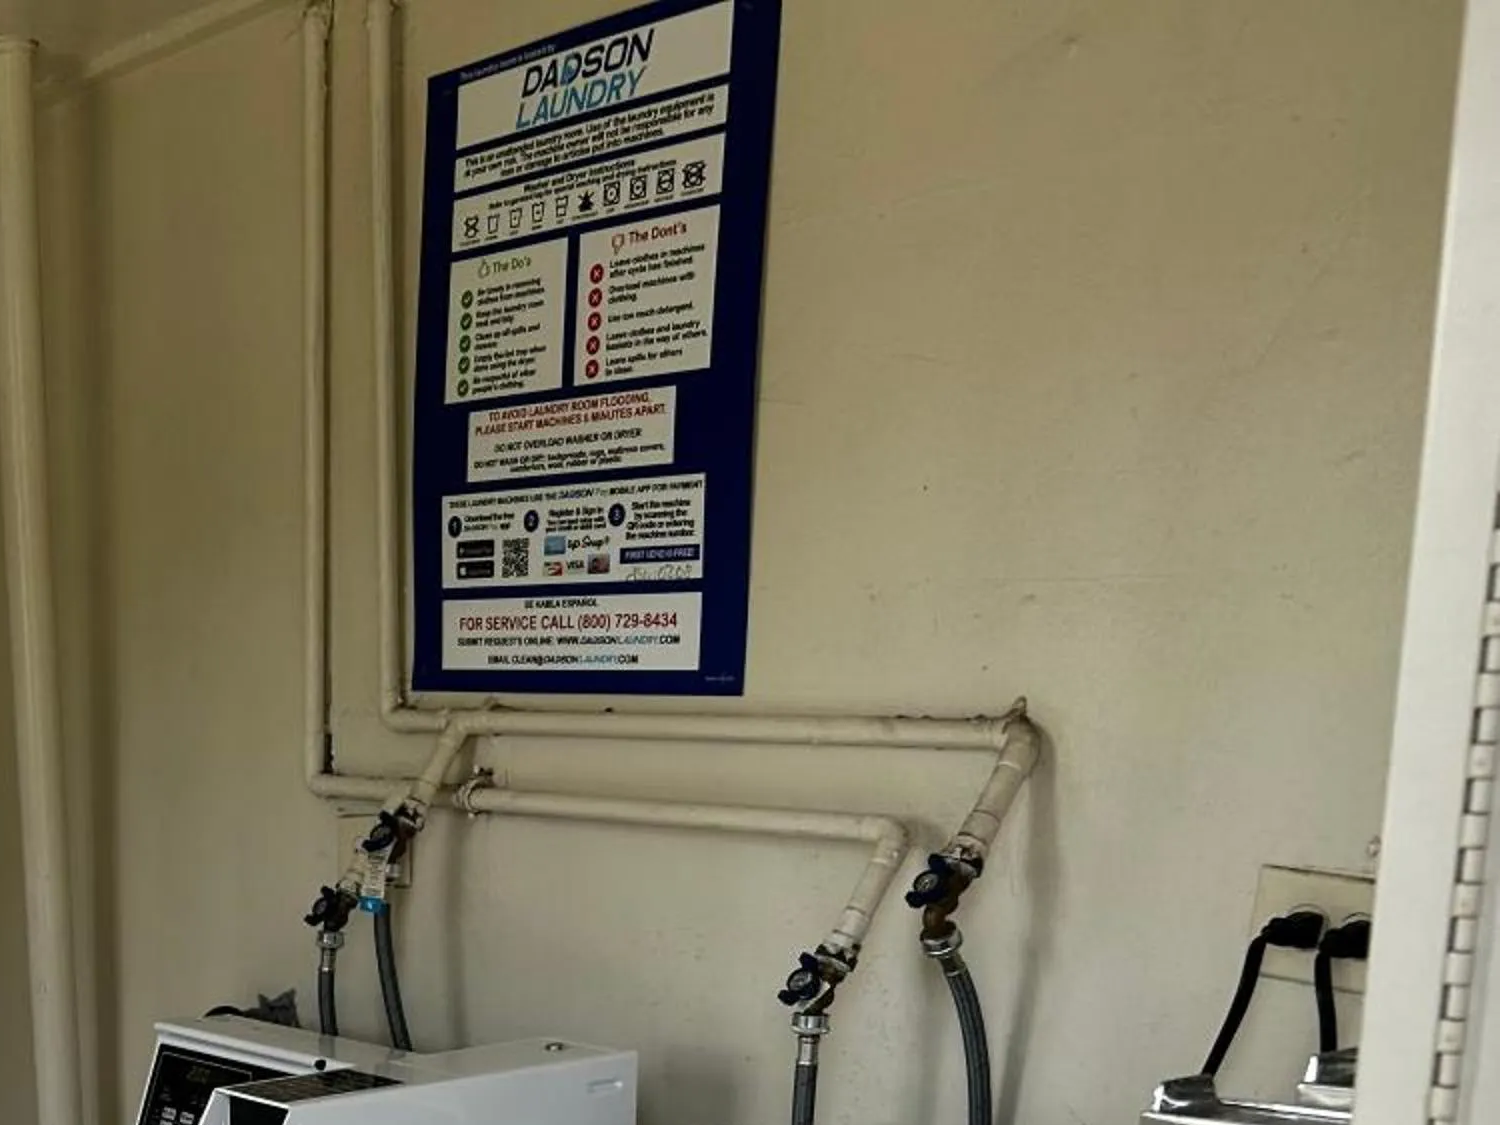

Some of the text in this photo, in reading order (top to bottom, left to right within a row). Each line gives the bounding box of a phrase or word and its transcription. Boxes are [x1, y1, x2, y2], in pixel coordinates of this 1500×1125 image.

[521, 28, 654, 99] DADSON
[515, 65, 649, 131] LAUNDRY
[627, 106, 657, 125] laundry
[551, 175, 564, 186] and
[628, 219, 687, 244] The Dont's
[492, 258, 508, 273] The
[529, 402, 568, 416] LAUNDRY
[571, 398, 598, 411] ROOM
[475, 422, 506, 436] PLEASE
[507, 419, 533, 432] START
[535, 413, 581, 428] MACHINES
[591, 406, 632, 421] MINUTES
[523, 436, 564, 449] OVERLOAD
[600, 430, 612, 440] OR
[614, 427, 641, 439] DRYER
[566, 559, 584, 568] VISA
[459, 611, 678, 632] FOR SERVICE CALL (800) 729-8434
